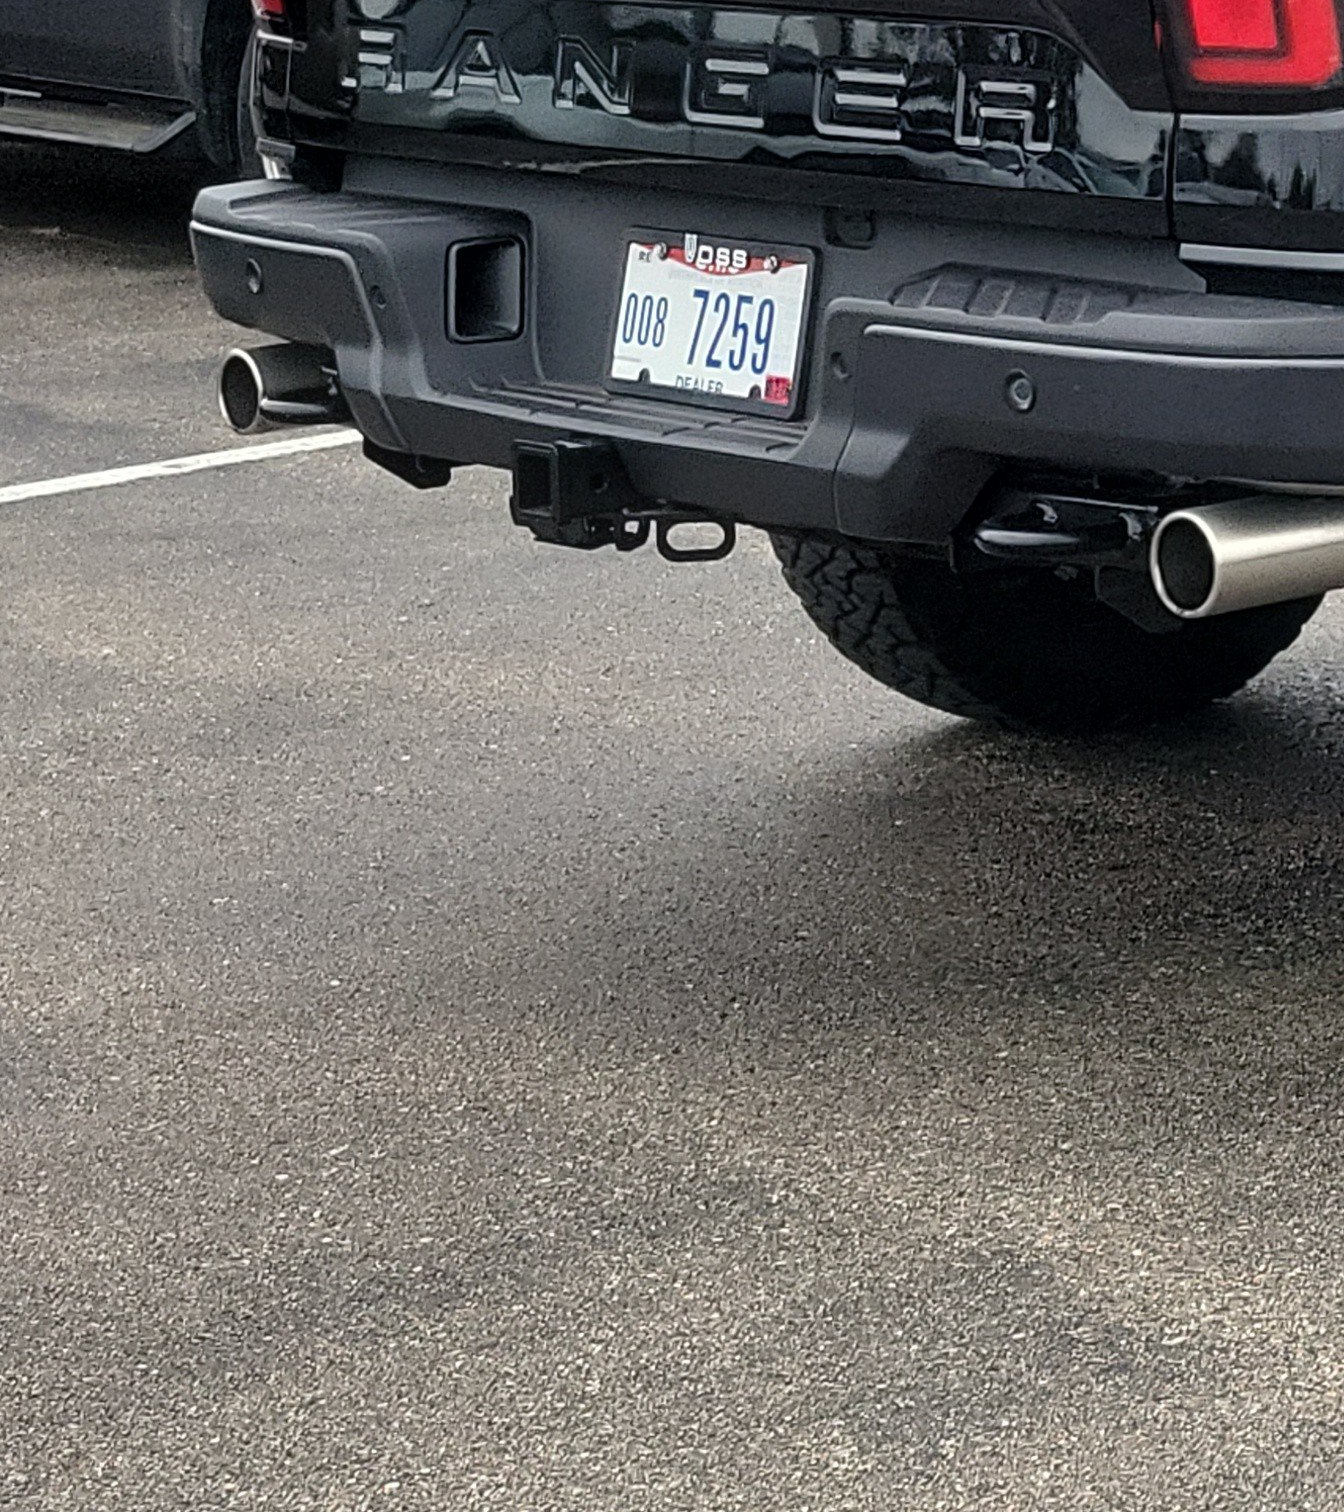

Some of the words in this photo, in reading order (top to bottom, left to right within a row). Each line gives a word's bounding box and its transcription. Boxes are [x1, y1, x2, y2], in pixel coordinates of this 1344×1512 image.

[622, 293, 669, 348] 008
[687, 288, 775, 375] 7259
[675, 374, 724, 394] DEALER
